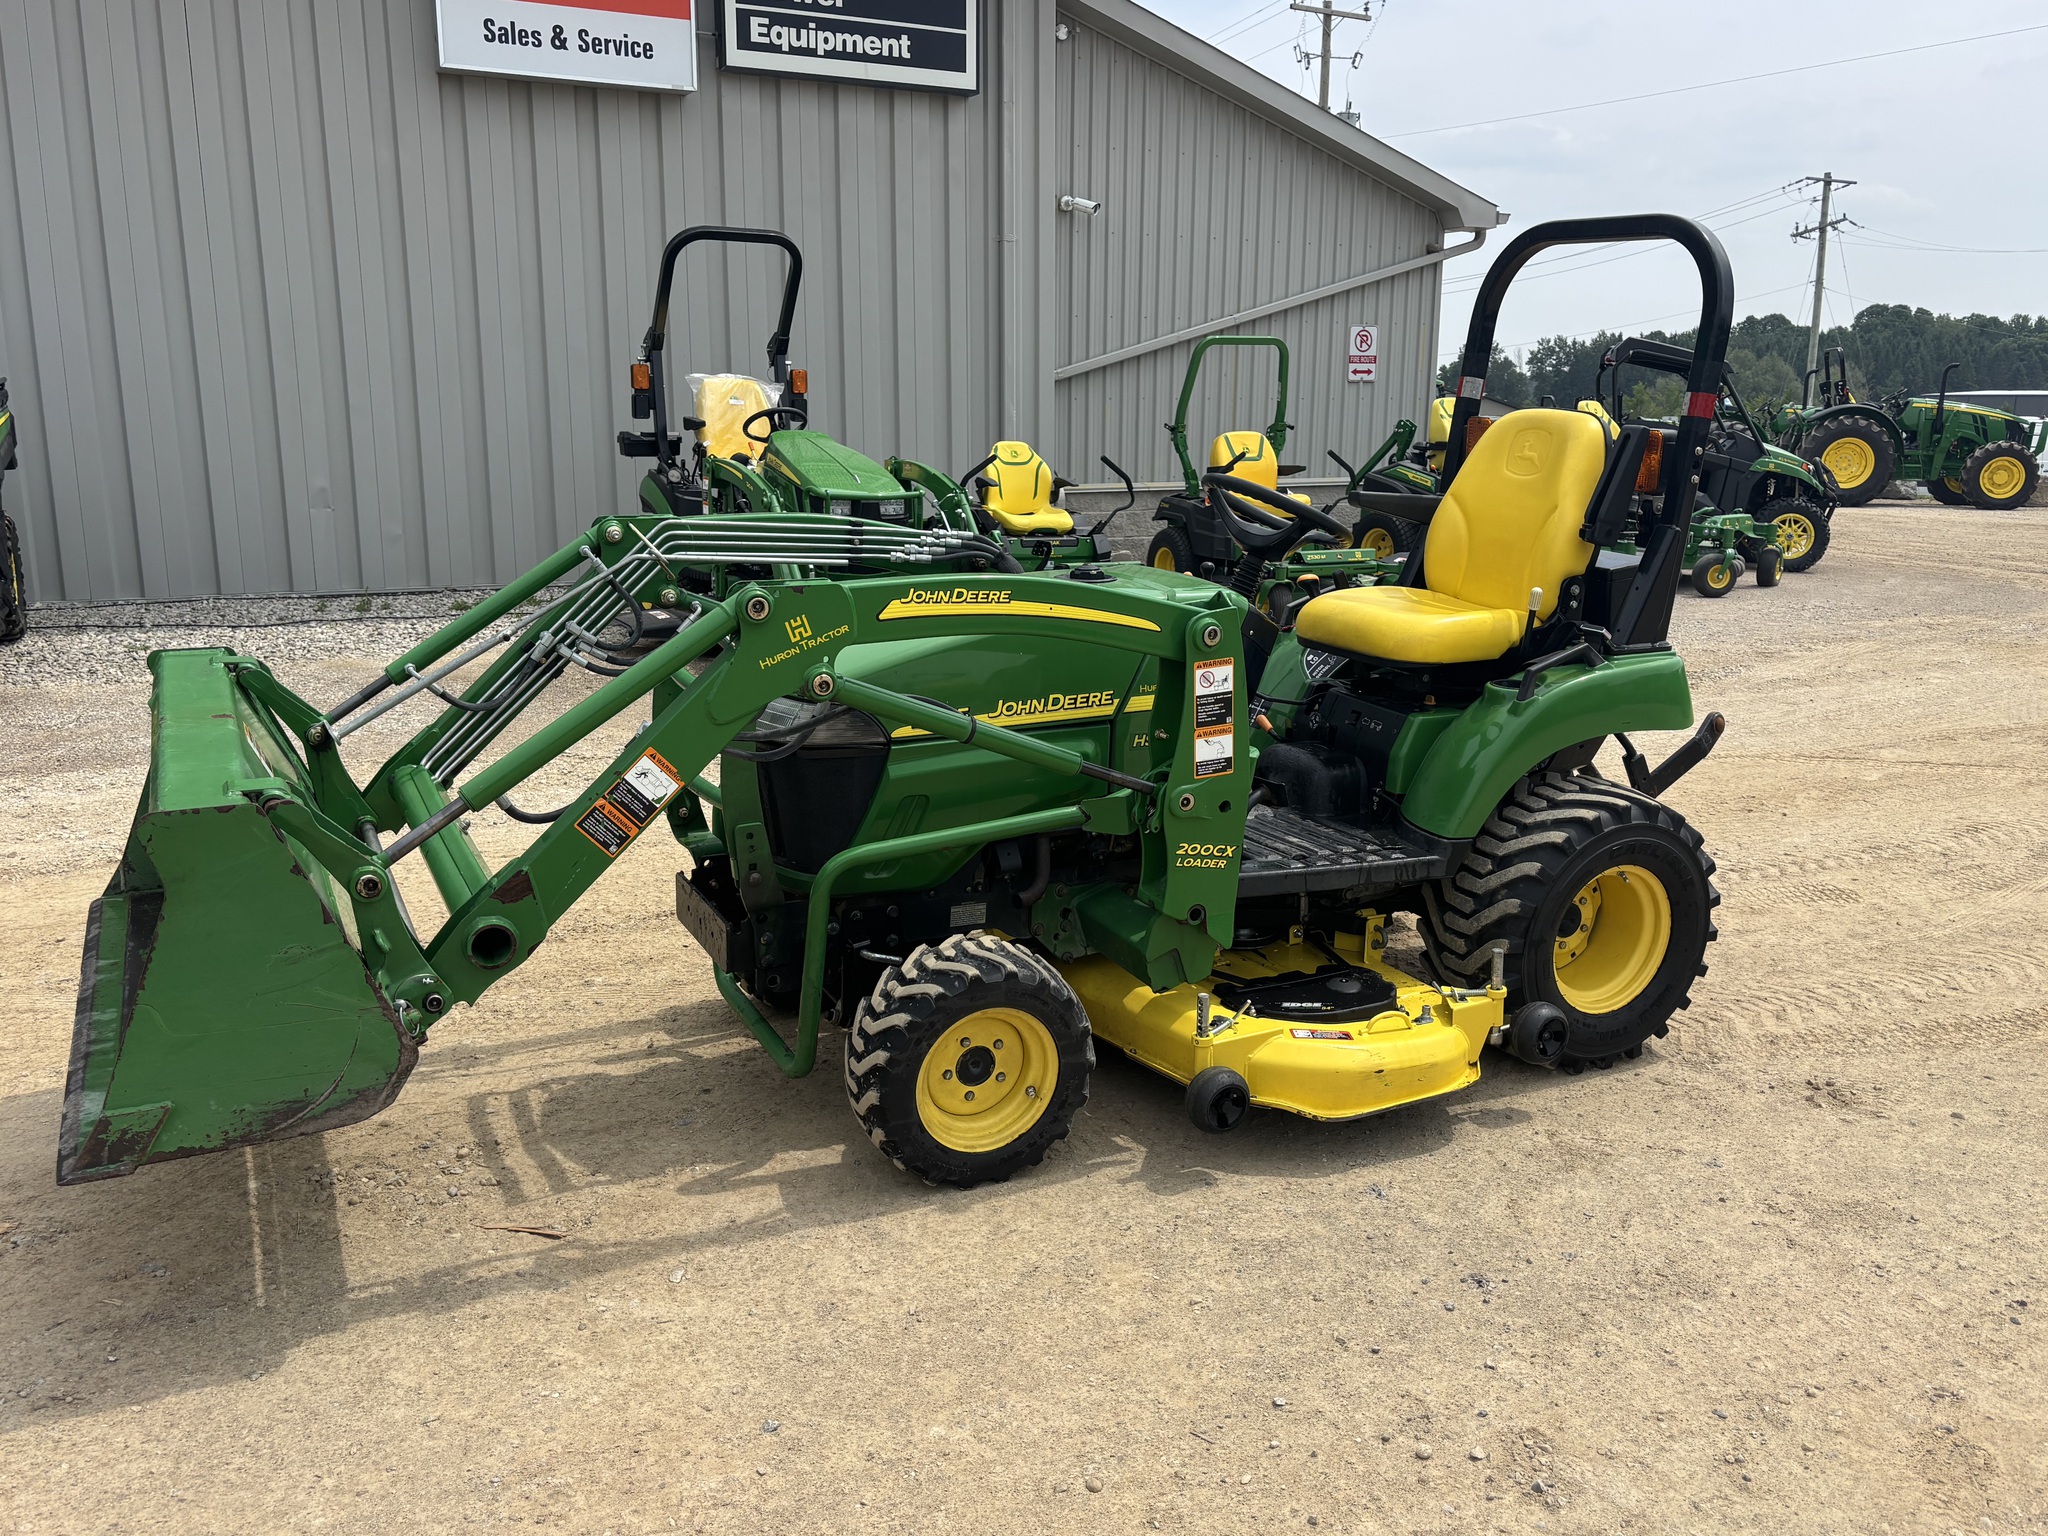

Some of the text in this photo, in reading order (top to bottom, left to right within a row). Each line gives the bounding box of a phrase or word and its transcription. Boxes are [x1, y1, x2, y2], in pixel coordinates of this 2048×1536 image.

[483, 18, 654, 59] Sales & Service
[750, 16, 911, 59] Equipment
[900, 588, 1012, 604] JOHN DEERE
[759, 624, 850, 670] HURON TRACTOR
[1202, 658, 1232, 668] WARNING
[988, 699, 1046, 718] JOHN
[1047, 690, 1114, 711] DEERE
[1202, 726, 1232, 737] WARNING
[656, 757, 682, 782] WARNING
[607, 808, 633, 833] WARNING
[1175, 843, 1237, 857] 200CX
[1175, 858, 1227, 869] LOADER
